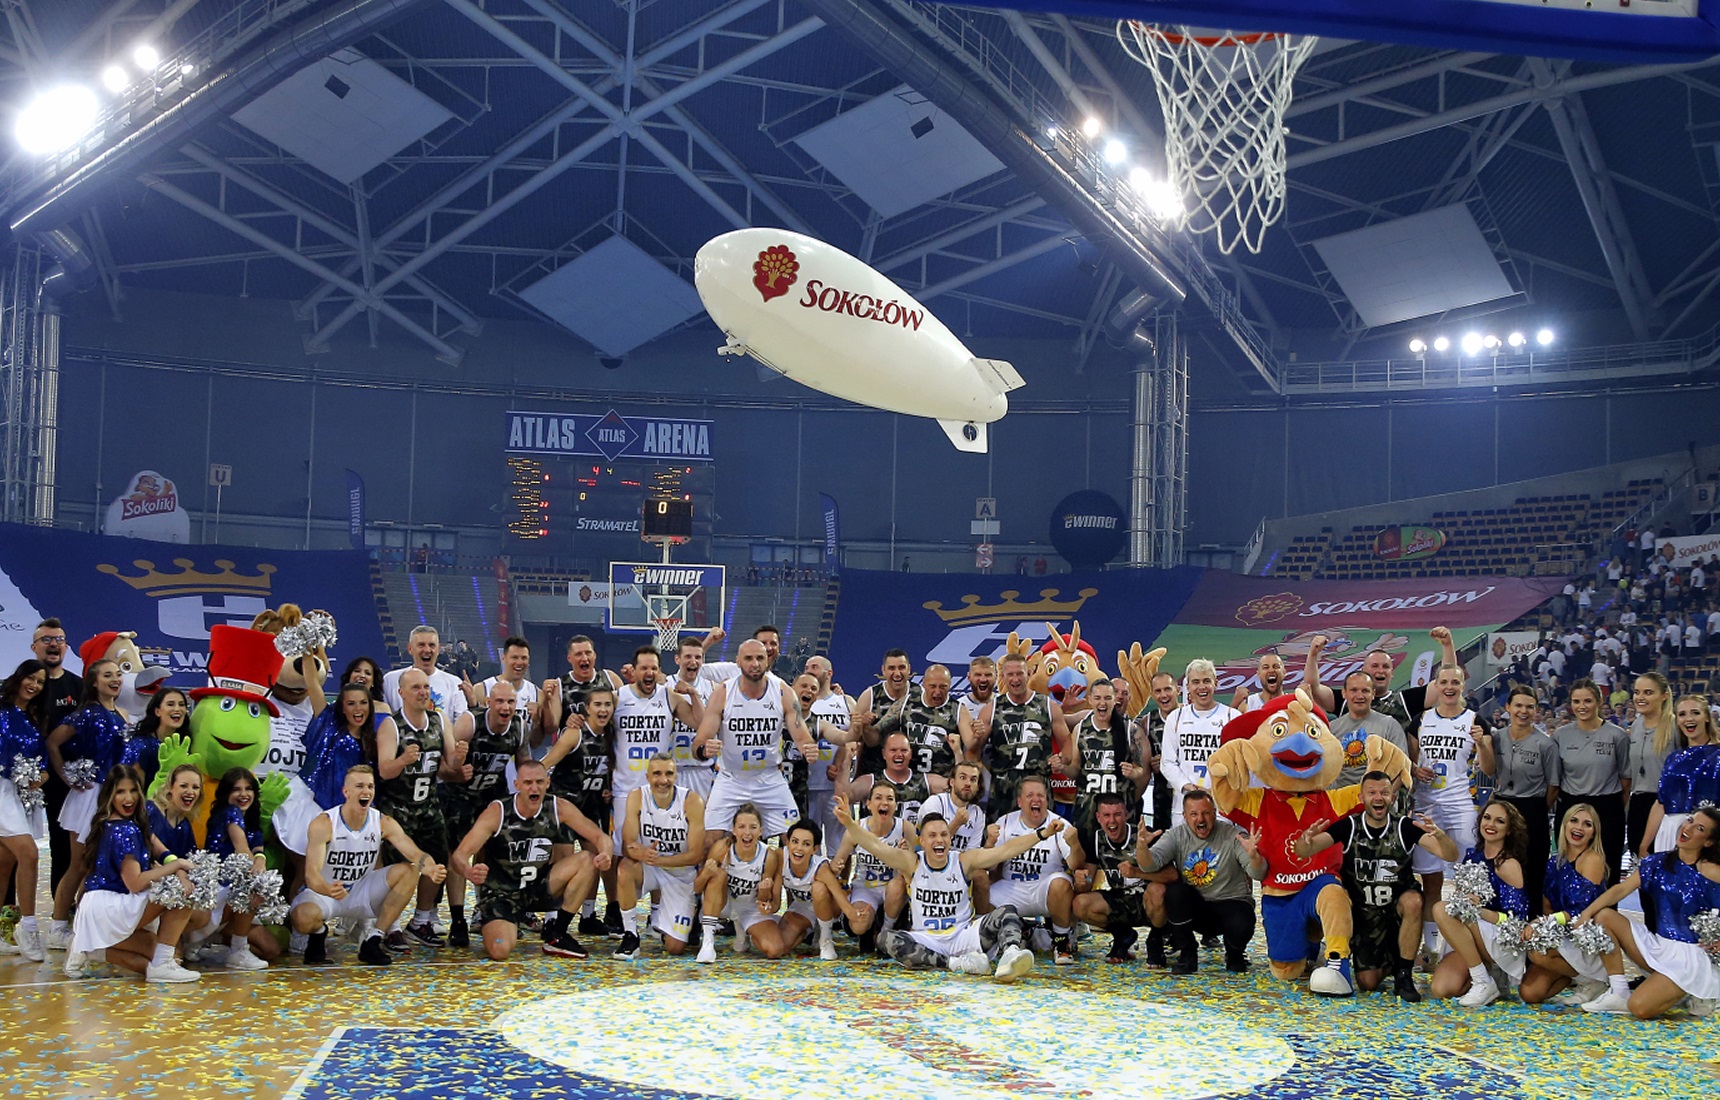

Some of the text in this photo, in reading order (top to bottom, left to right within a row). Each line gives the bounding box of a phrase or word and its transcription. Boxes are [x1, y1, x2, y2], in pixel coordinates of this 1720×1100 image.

[800, 279, 924, 331] SOKOŁÓW
[509, 416, 710, 455] ATLAS ARENA
[598, 428, 626, 443] ATLAS
[215, 470, 226, 483] U
[580, 492, 586, 500] 0
[124, 497, 174, 516] Sokoliki
[658, 501, 668, 514] 0
[980, 503, 992, 516] A
[577, 517, 639, 532] STRAMATEL
[1064, 514, 1118, 529] ewinner
[634, 569, 704, 585] ewinner
[1299, 586, 1495, 617] SOKOŁÓW
[620, 715, 666, 729] GORTAT
[728, 717, 778, 732] GORTAT
[625, 731, 660, 743] TEAM
[735, 733, 772, 747] TEAM
[1420, 734, 1467, 749] GORTAT
[741, 749, 766, 771] 13
[917, 749, 933, 773] 3
[1015, 747, 1029, 770] 7
[1424, 748, 1457, 761] TEAM
[469, 773, 499, 790] 12
[1086, 773, 1117, 794] 20
[1193, 765, 1208, 788] 7
[413, 777, 431, 801] 6
[643, 824, 686, 841] GORTAT
[327, 851, 378, 867] GORTAT
[332, 867, 368, 881] TEAM
[915, 888, 963, 905] GORTAT
[1363, 885, 1392, 906] 18
[921, 905, 957, 918] TEAM
[672, 914, 691, 935] 10
